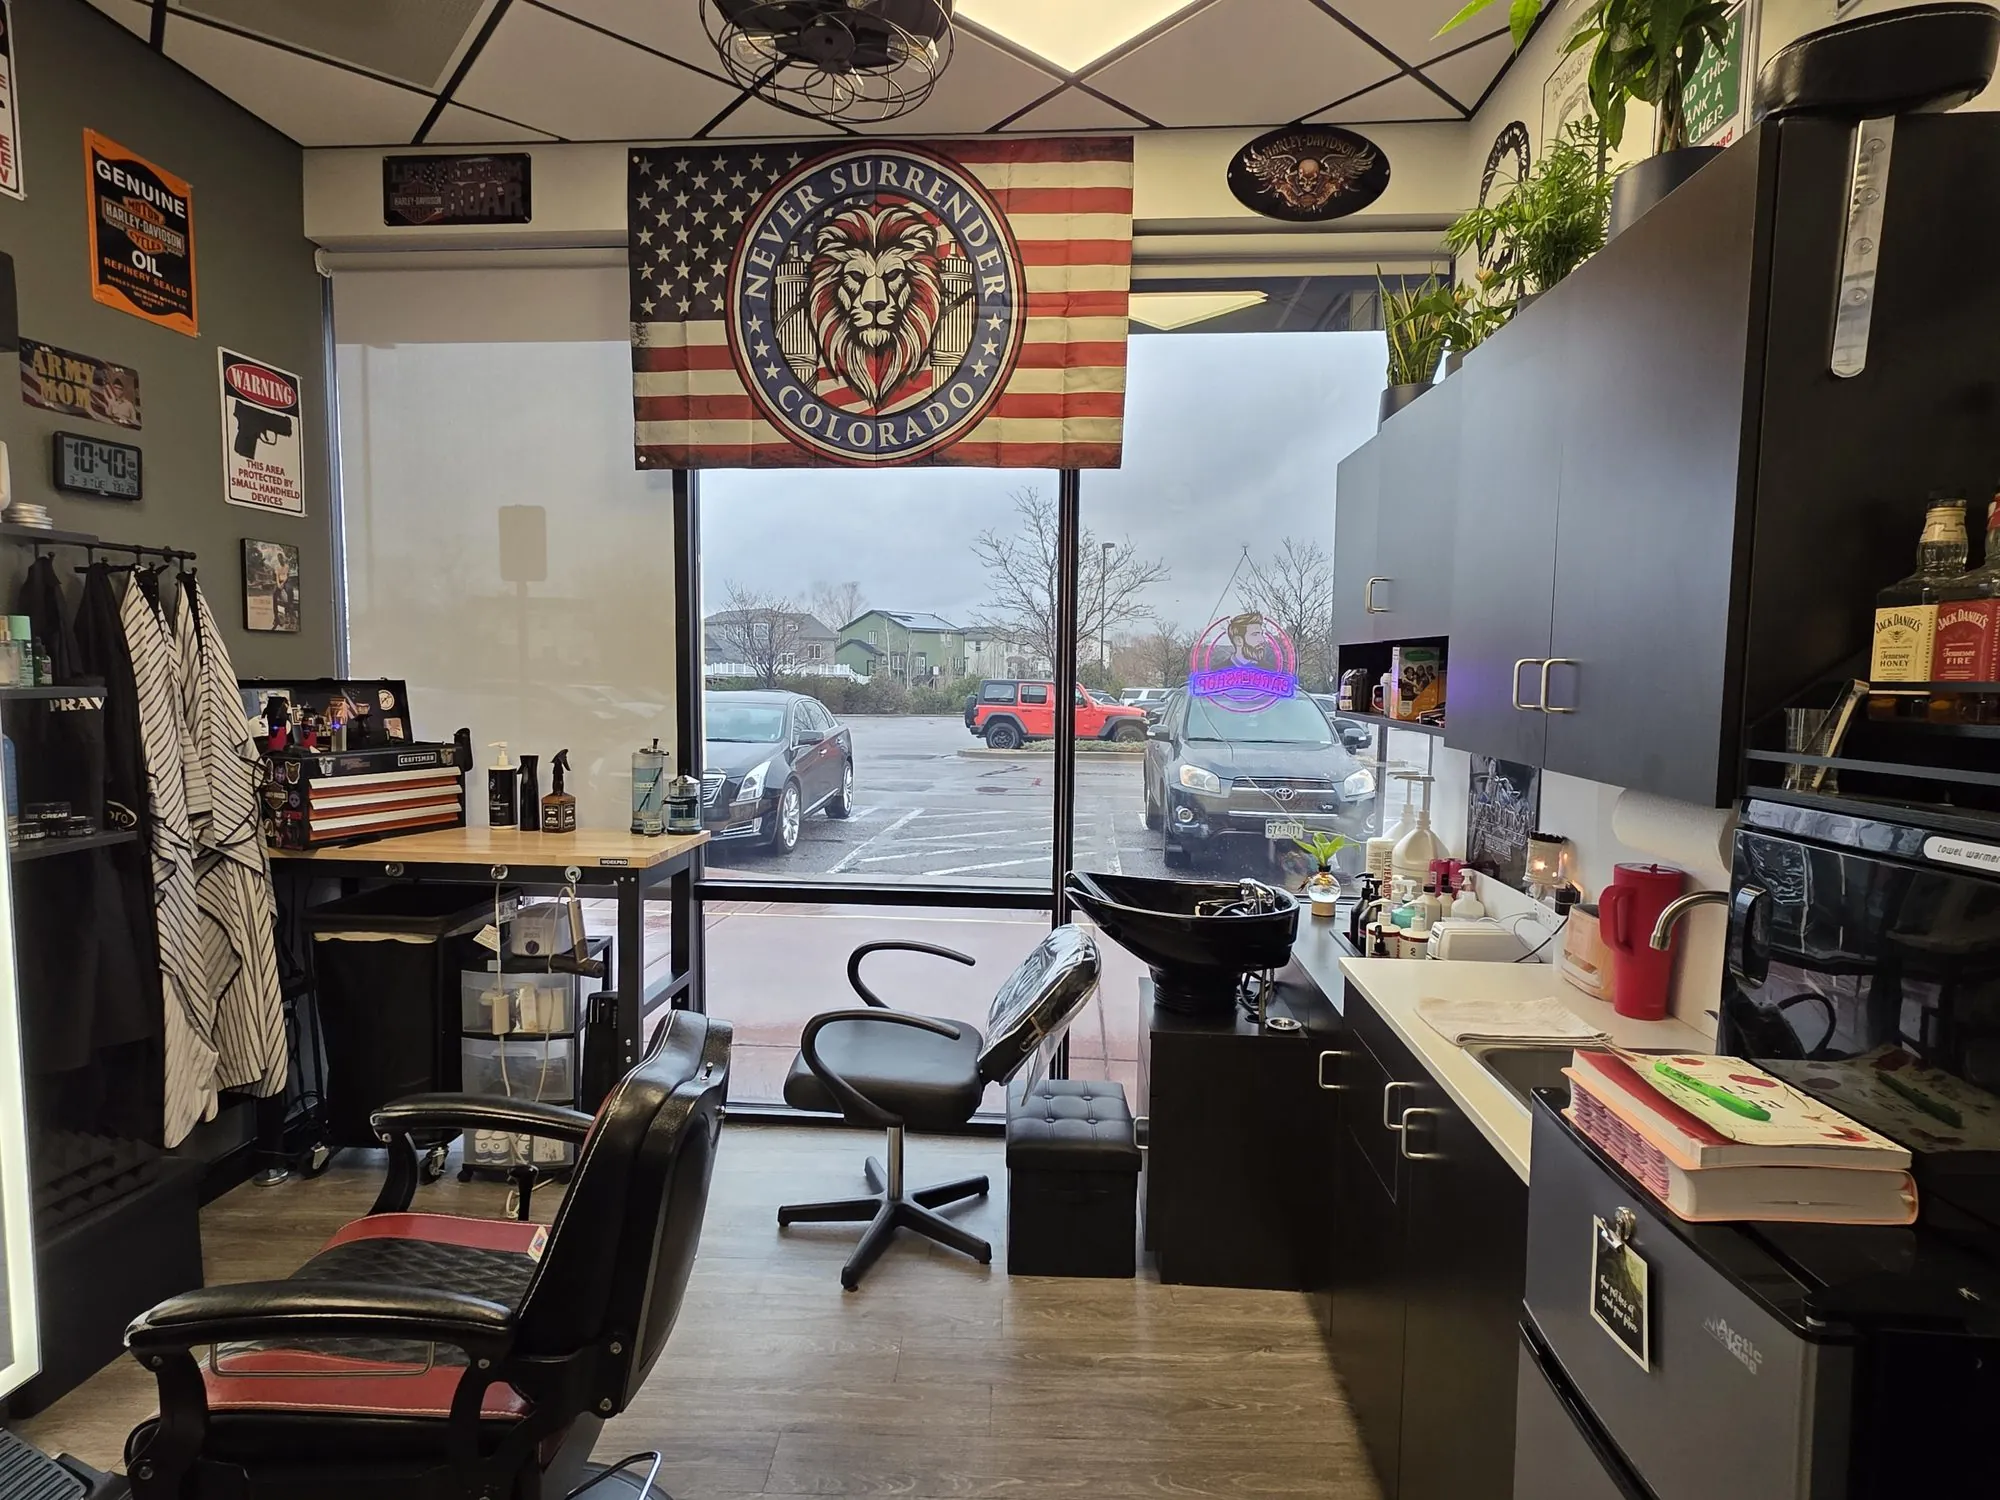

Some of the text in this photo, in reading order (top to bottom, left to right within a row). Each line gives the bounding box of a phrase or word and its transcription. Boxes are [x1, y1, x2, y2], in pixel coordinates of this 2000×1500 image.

[1714, 82, 1723, 101] A
[1689, 104, 1724, 143] CHER
[96, 159, 186, 219] GENUINE
[105, 202, 183, 250] HARLEY-DAVIDSON
[744, 159, 1007, 301] NEVER SURRENDER
[104, 257, 151, 283] REFINERY
[154, 278, 188, 299] SEALED
[132, 250, 163, 278] OIL
[32, 349, 96, 386] ARMY
[39, 378, 92, 409] MOM
[231, 367, 293, 405] WARNING
[775, 380, 977, 450] COLORADO
[74, 442, 127, 479] 10:40
[246, 459, 286, 477] THIS AREA
[231, 477, 300, 500] SMALL HANDHELD
[238, 468, 294, 488] PROTECTED BY
[251, 492, 283, 506] DEVICES
[1875, 613, 1923, 634] JACK DANIEL'S
[1938, 608, 1989, 631] JACK DANIEL'S
[400, 755, 434, 763] CRAFTSMAN
[1937, 844, 2000, 863] towel warmer
[1720, 1318, 1763, 1364] Arctic
